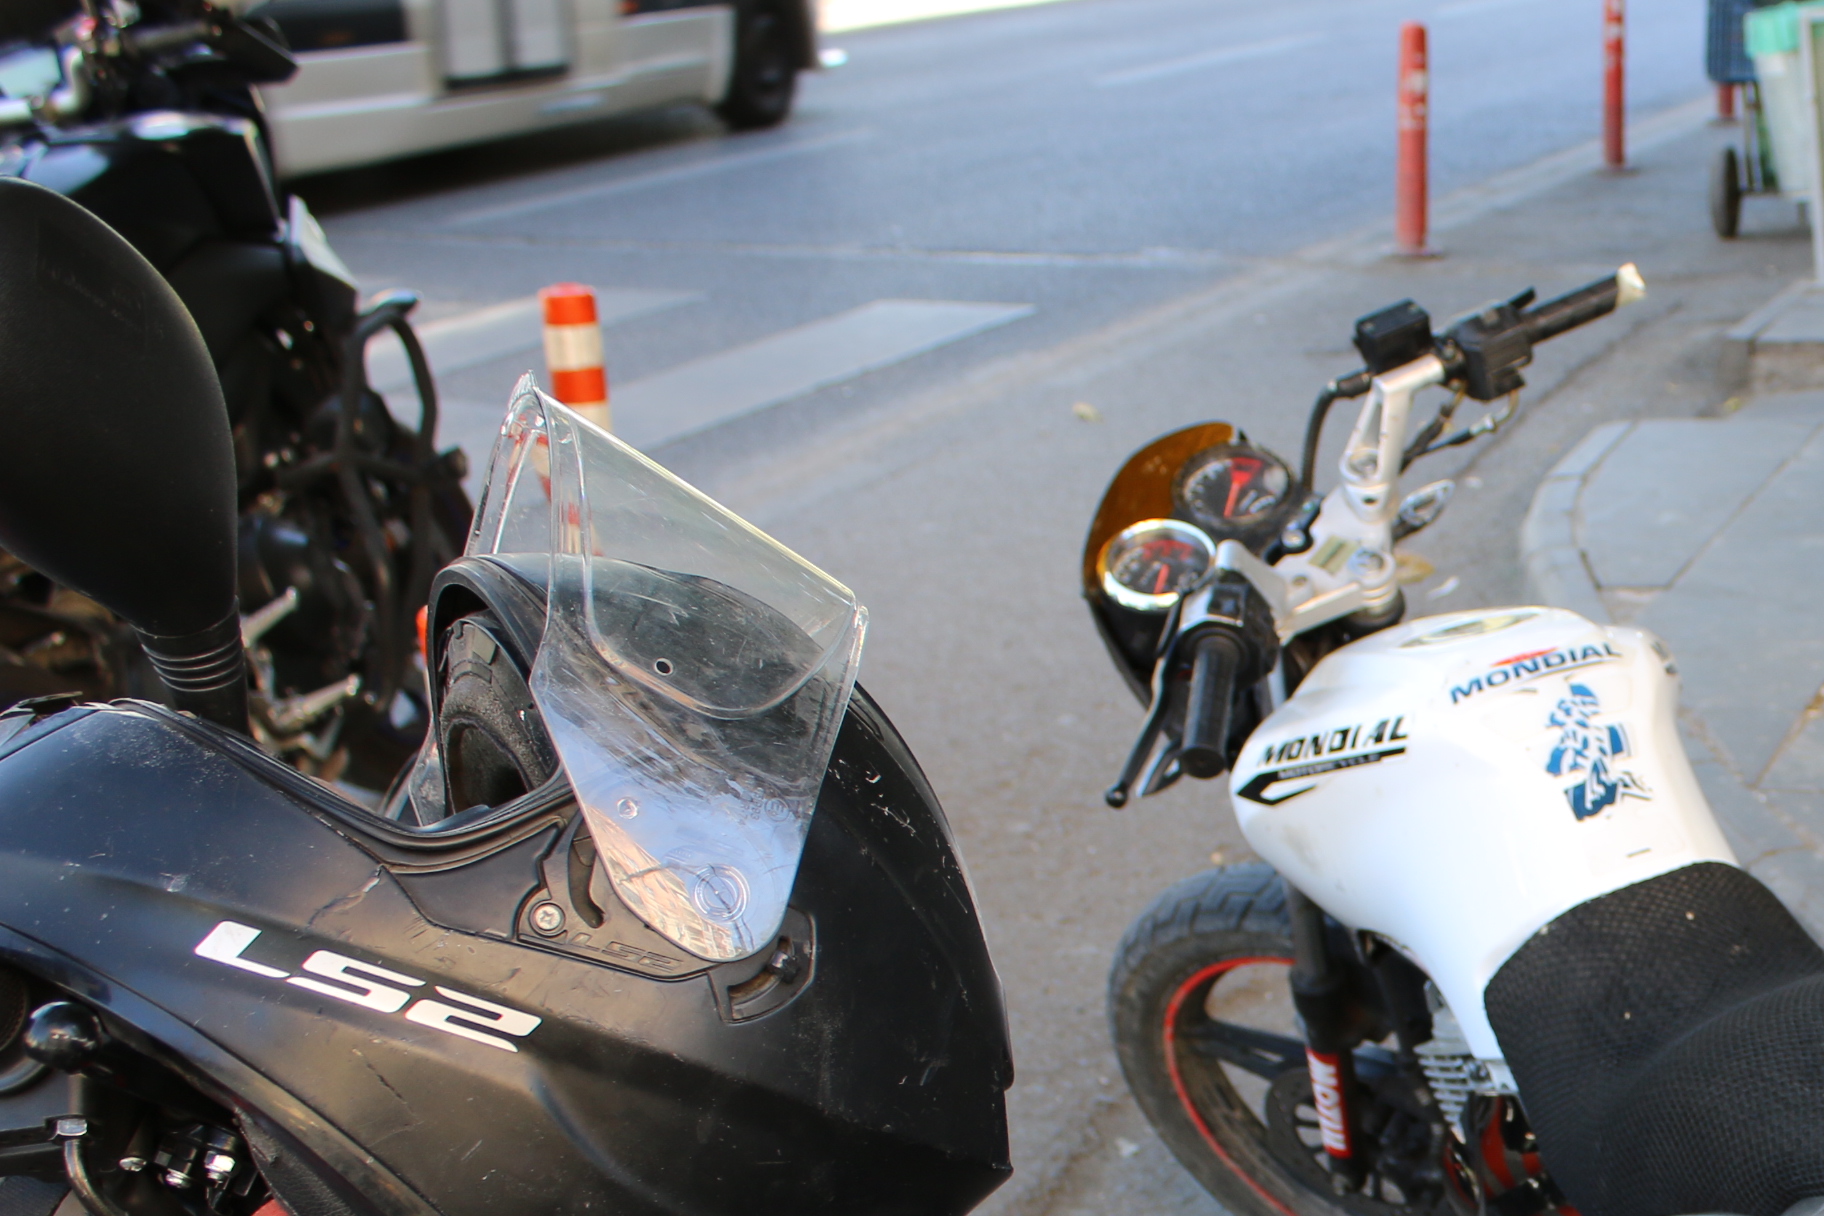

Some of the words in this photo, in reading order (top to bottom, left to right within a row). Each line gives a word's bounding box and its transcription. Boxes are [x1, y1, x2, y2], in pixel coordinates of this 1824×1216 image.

[1450, 642, 1624, 704] MONDIAL
[1257, 714, 1409, 766] MONDIAL
[567, 931, 684, 974] LS2
[194, 920, 543, 1053] LS2
